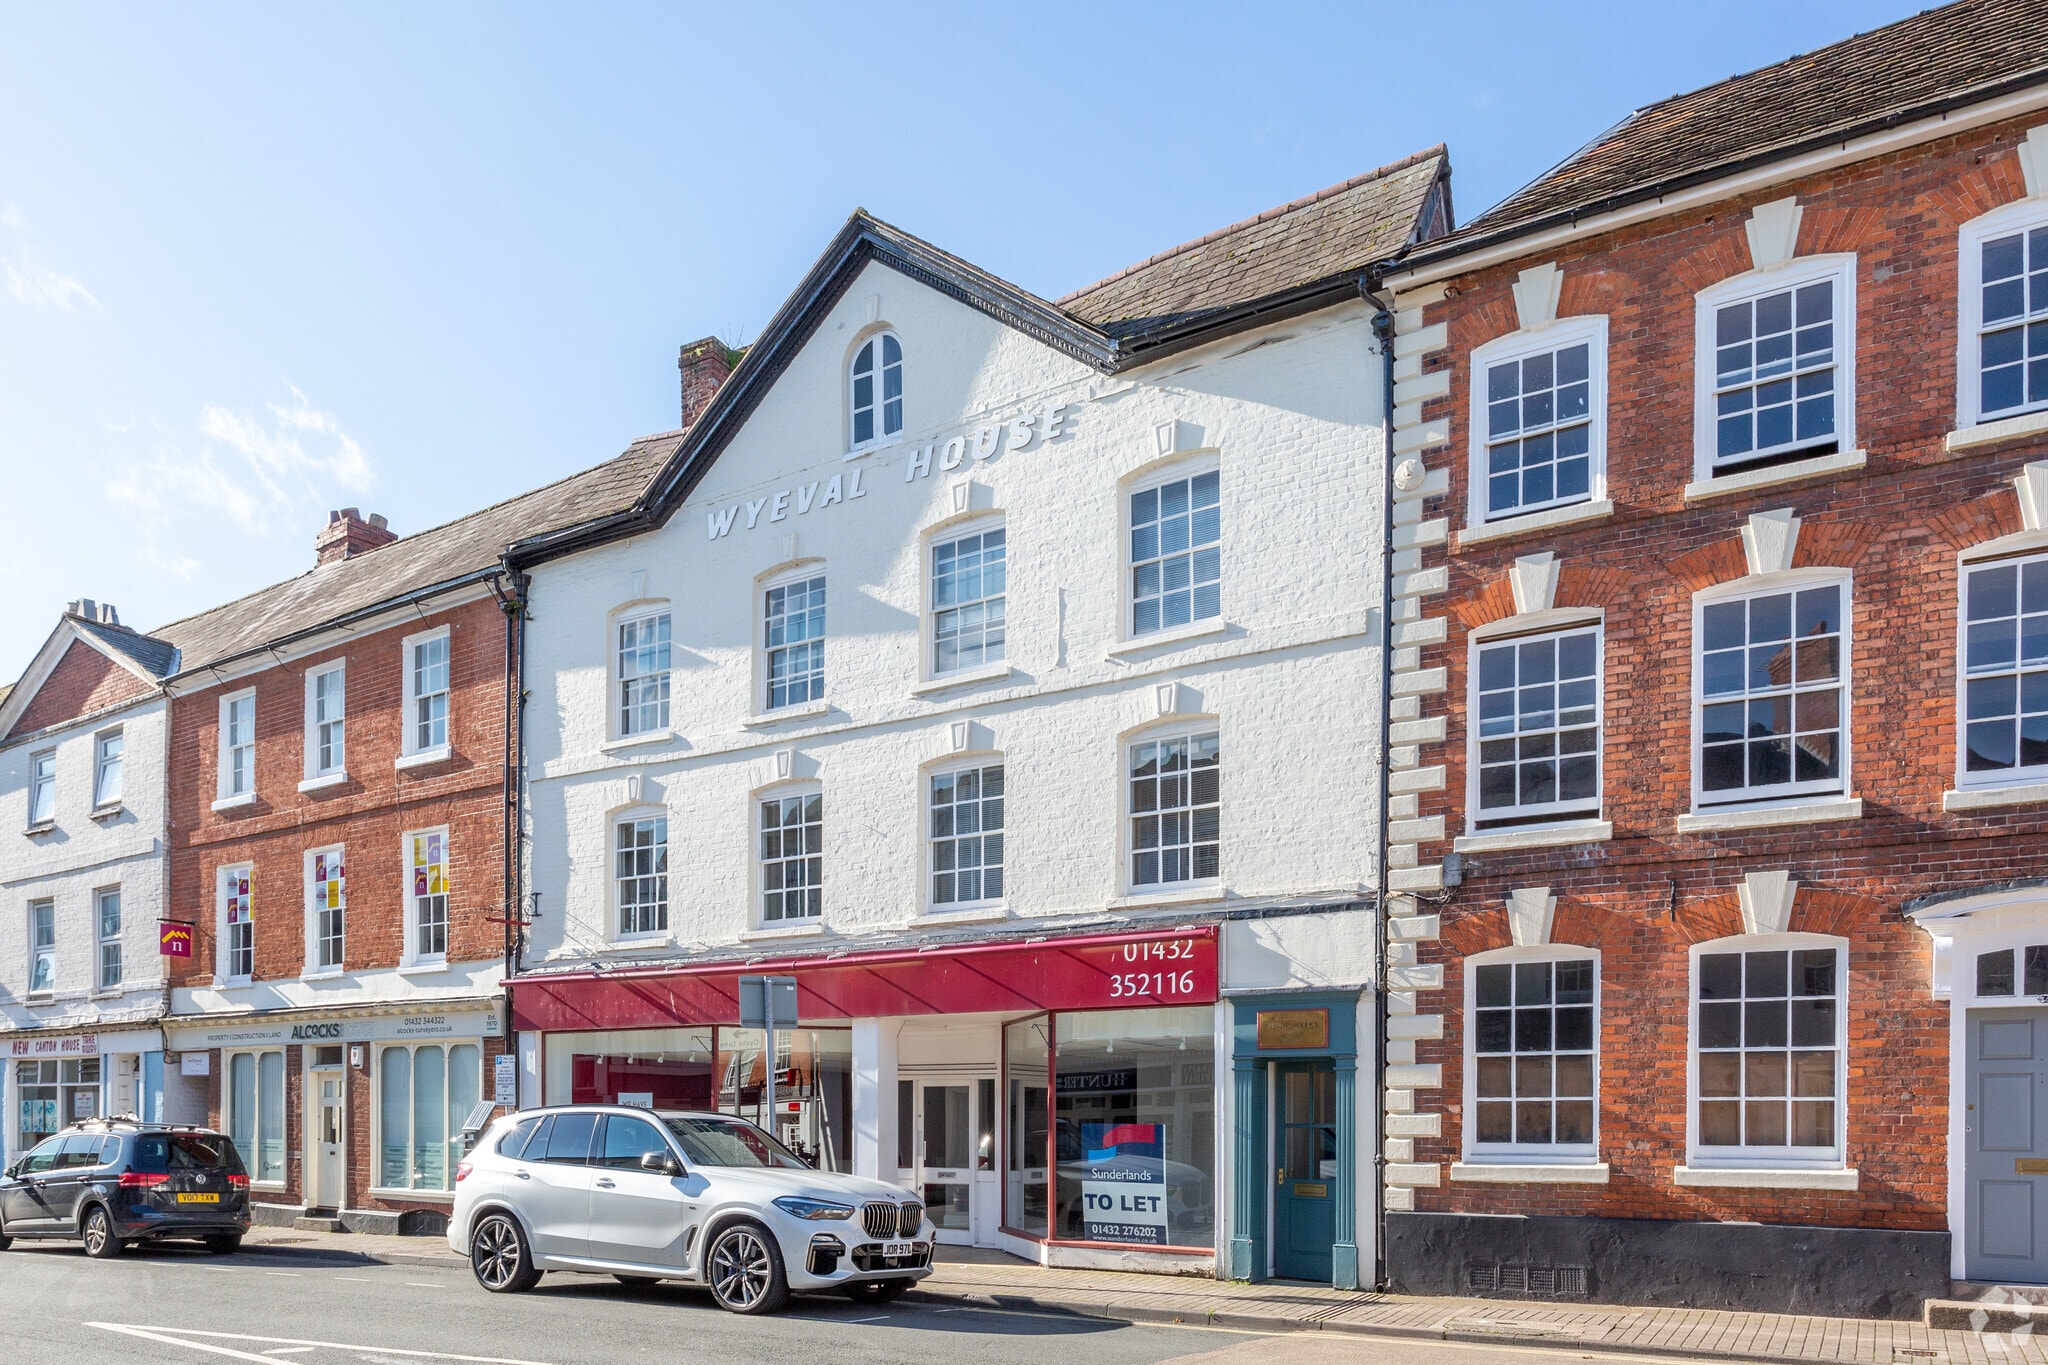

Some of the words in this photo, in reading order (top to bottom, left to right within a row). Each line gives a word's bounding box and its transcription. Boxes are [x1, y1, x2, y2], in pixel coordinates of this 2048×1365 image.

[707, 467, 867, 541] WYEVAL
[905, 402, 1068, 483] HOUSE
[1123, 939, 1194, 962] 01432
[1110, 970, 1194, 997] 352116
[404, 1017, 422, 1026] 01432
[423, 1016, 445, 1025] 344322
[1292, 1021, 1320, 1029] WEEKS
[232, 1032, 266, 1041] CONSTRUCTION
[269, 1031, 282, 1039] LAND
[397, 1025, 453, 1034] alcocks-surveyors.co.uk
[12, 1041, 29, 1055] NEW
[35, 1040, 58, 1053] CANTON
[61, 1038, 80, 1052] HOUSE
[1091, 1168, 1152, 1181] Sunderlands
[1084, 1193, 1113, 1211] TO
[1121, 1195, 1161, 1213] LET
[1091, 1224, 1120, 1235] 01432
[1122, 1225, 1157, 1237] 276202
[1092, 1235, 1157, 1244] www.sunderlands.co.uk
